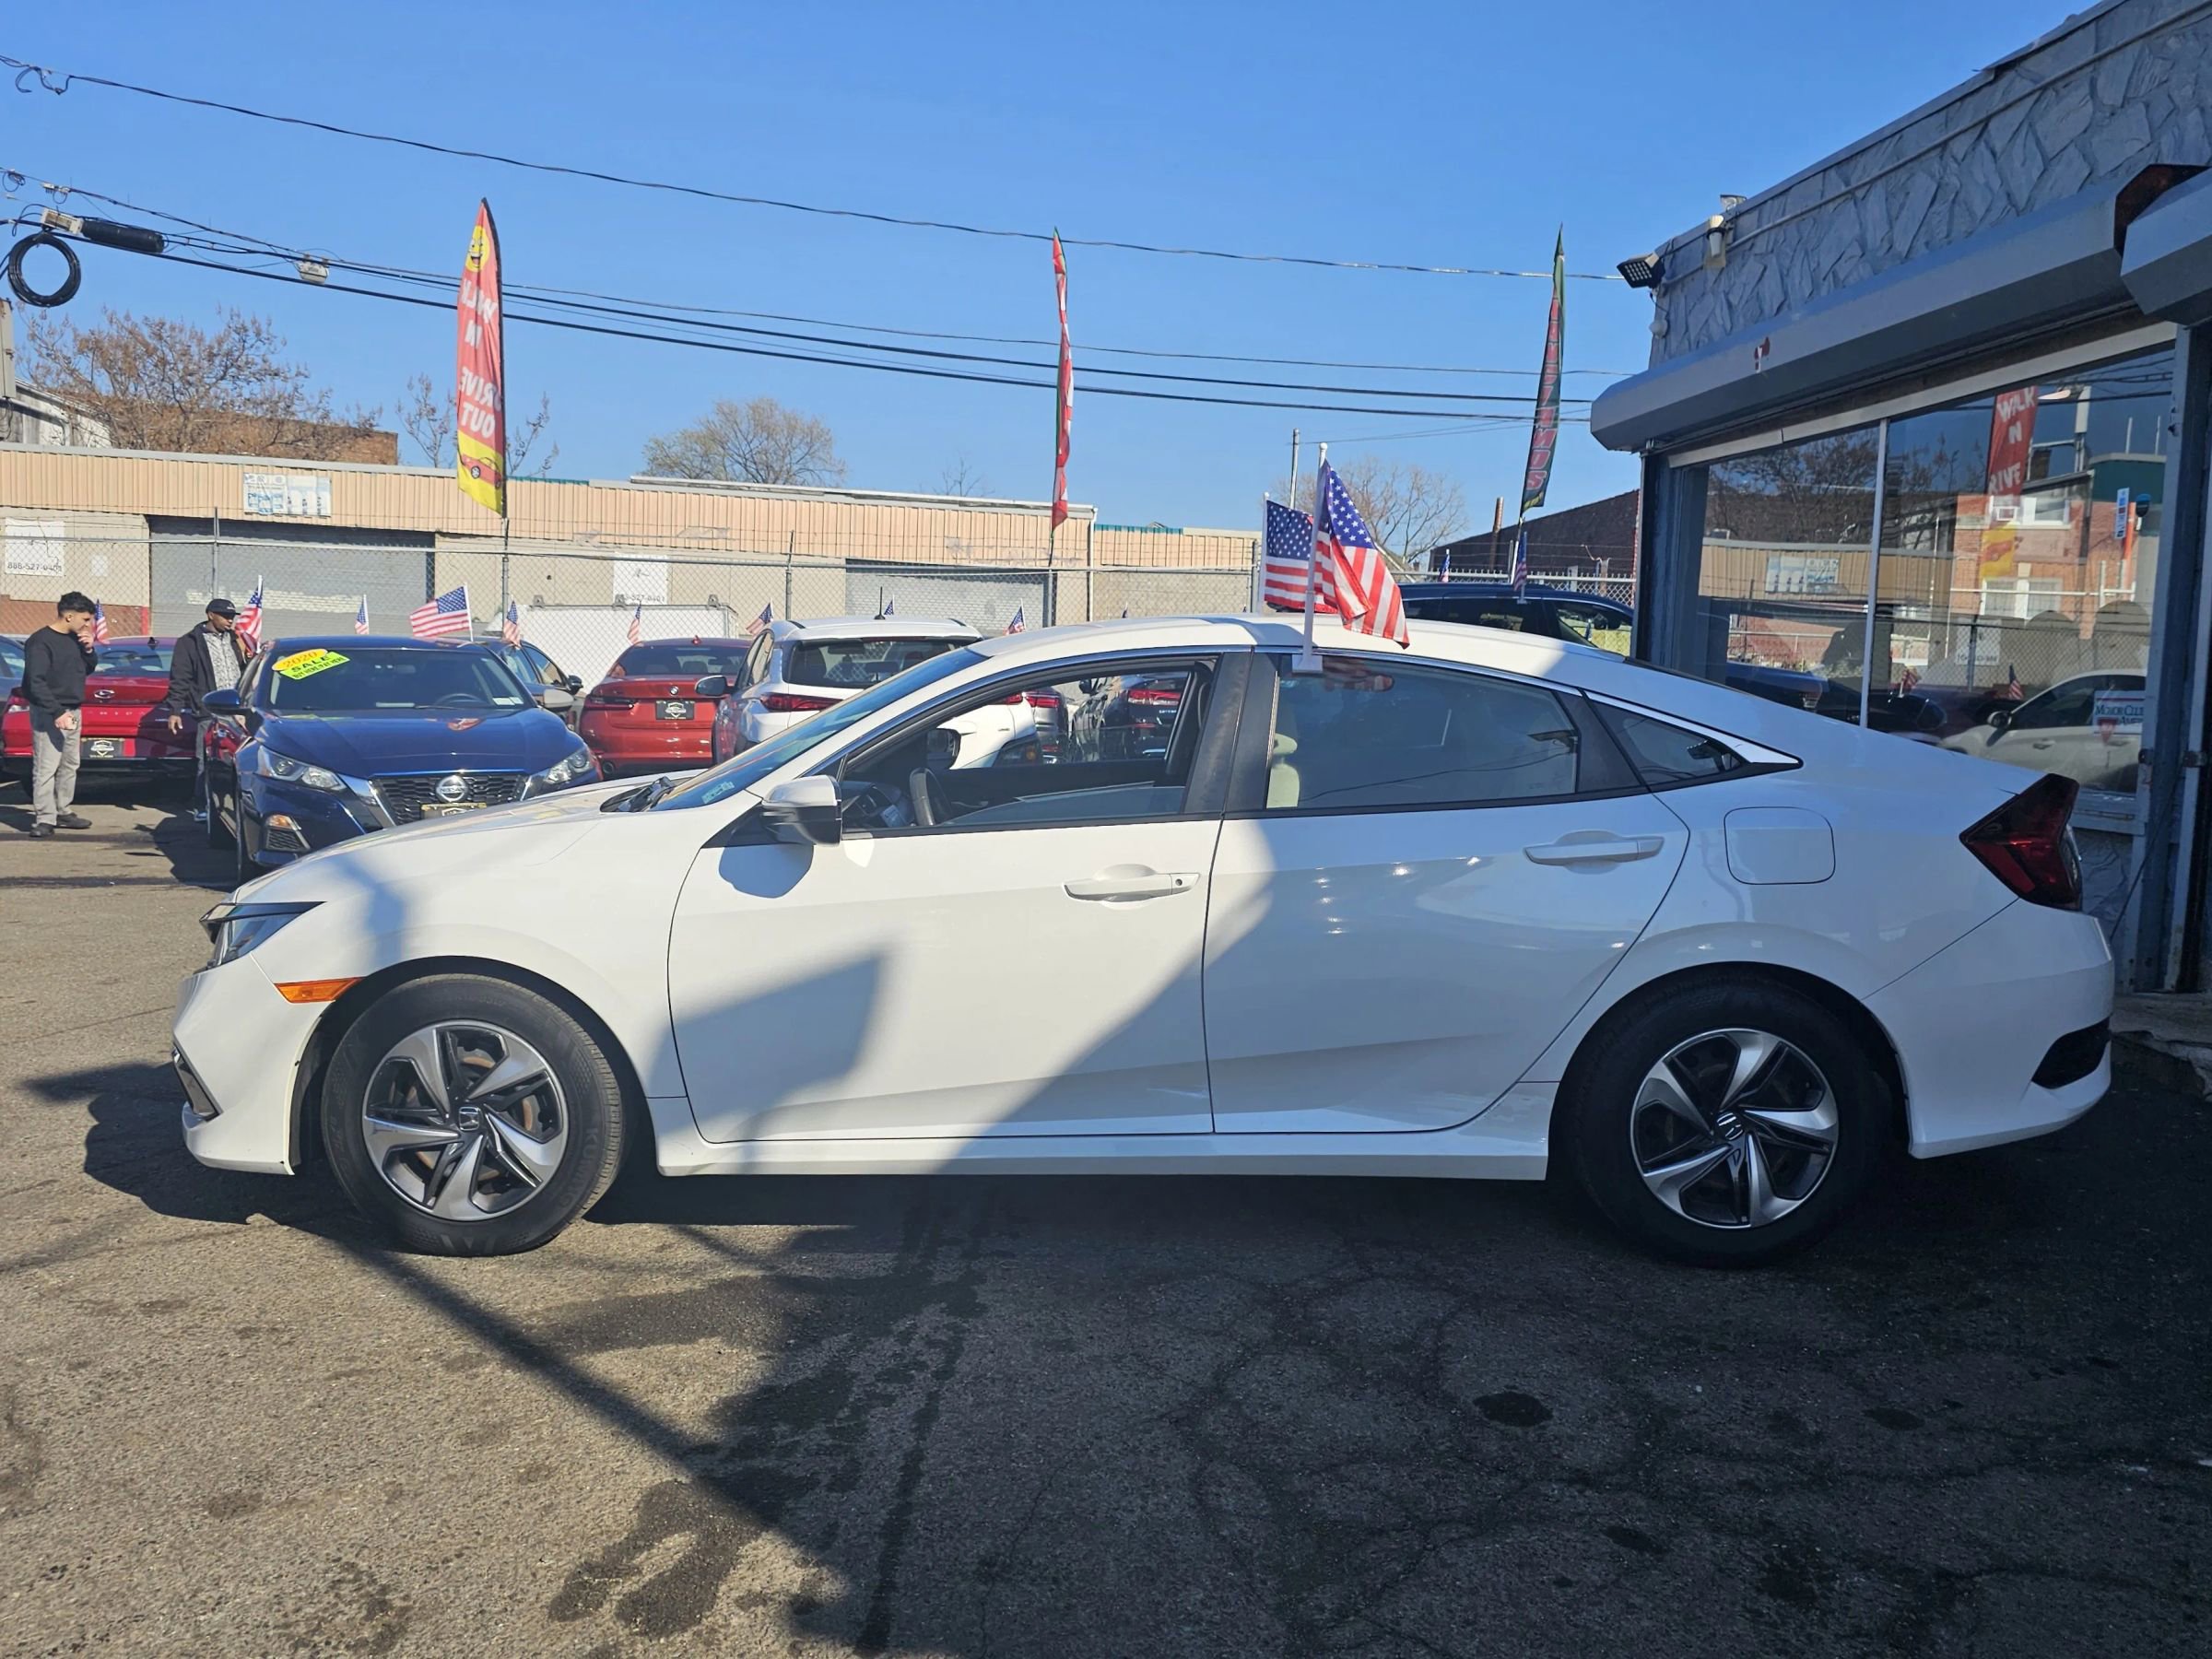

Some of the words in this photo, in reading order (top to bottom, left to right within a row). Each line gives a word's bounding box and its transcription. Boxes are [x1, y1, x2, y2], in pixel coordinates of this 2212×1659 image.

[1988, 462, 2021, 495] RIVE
[284, 652, 318, 667] 2020
[291, 655, 331, 672] SALE
